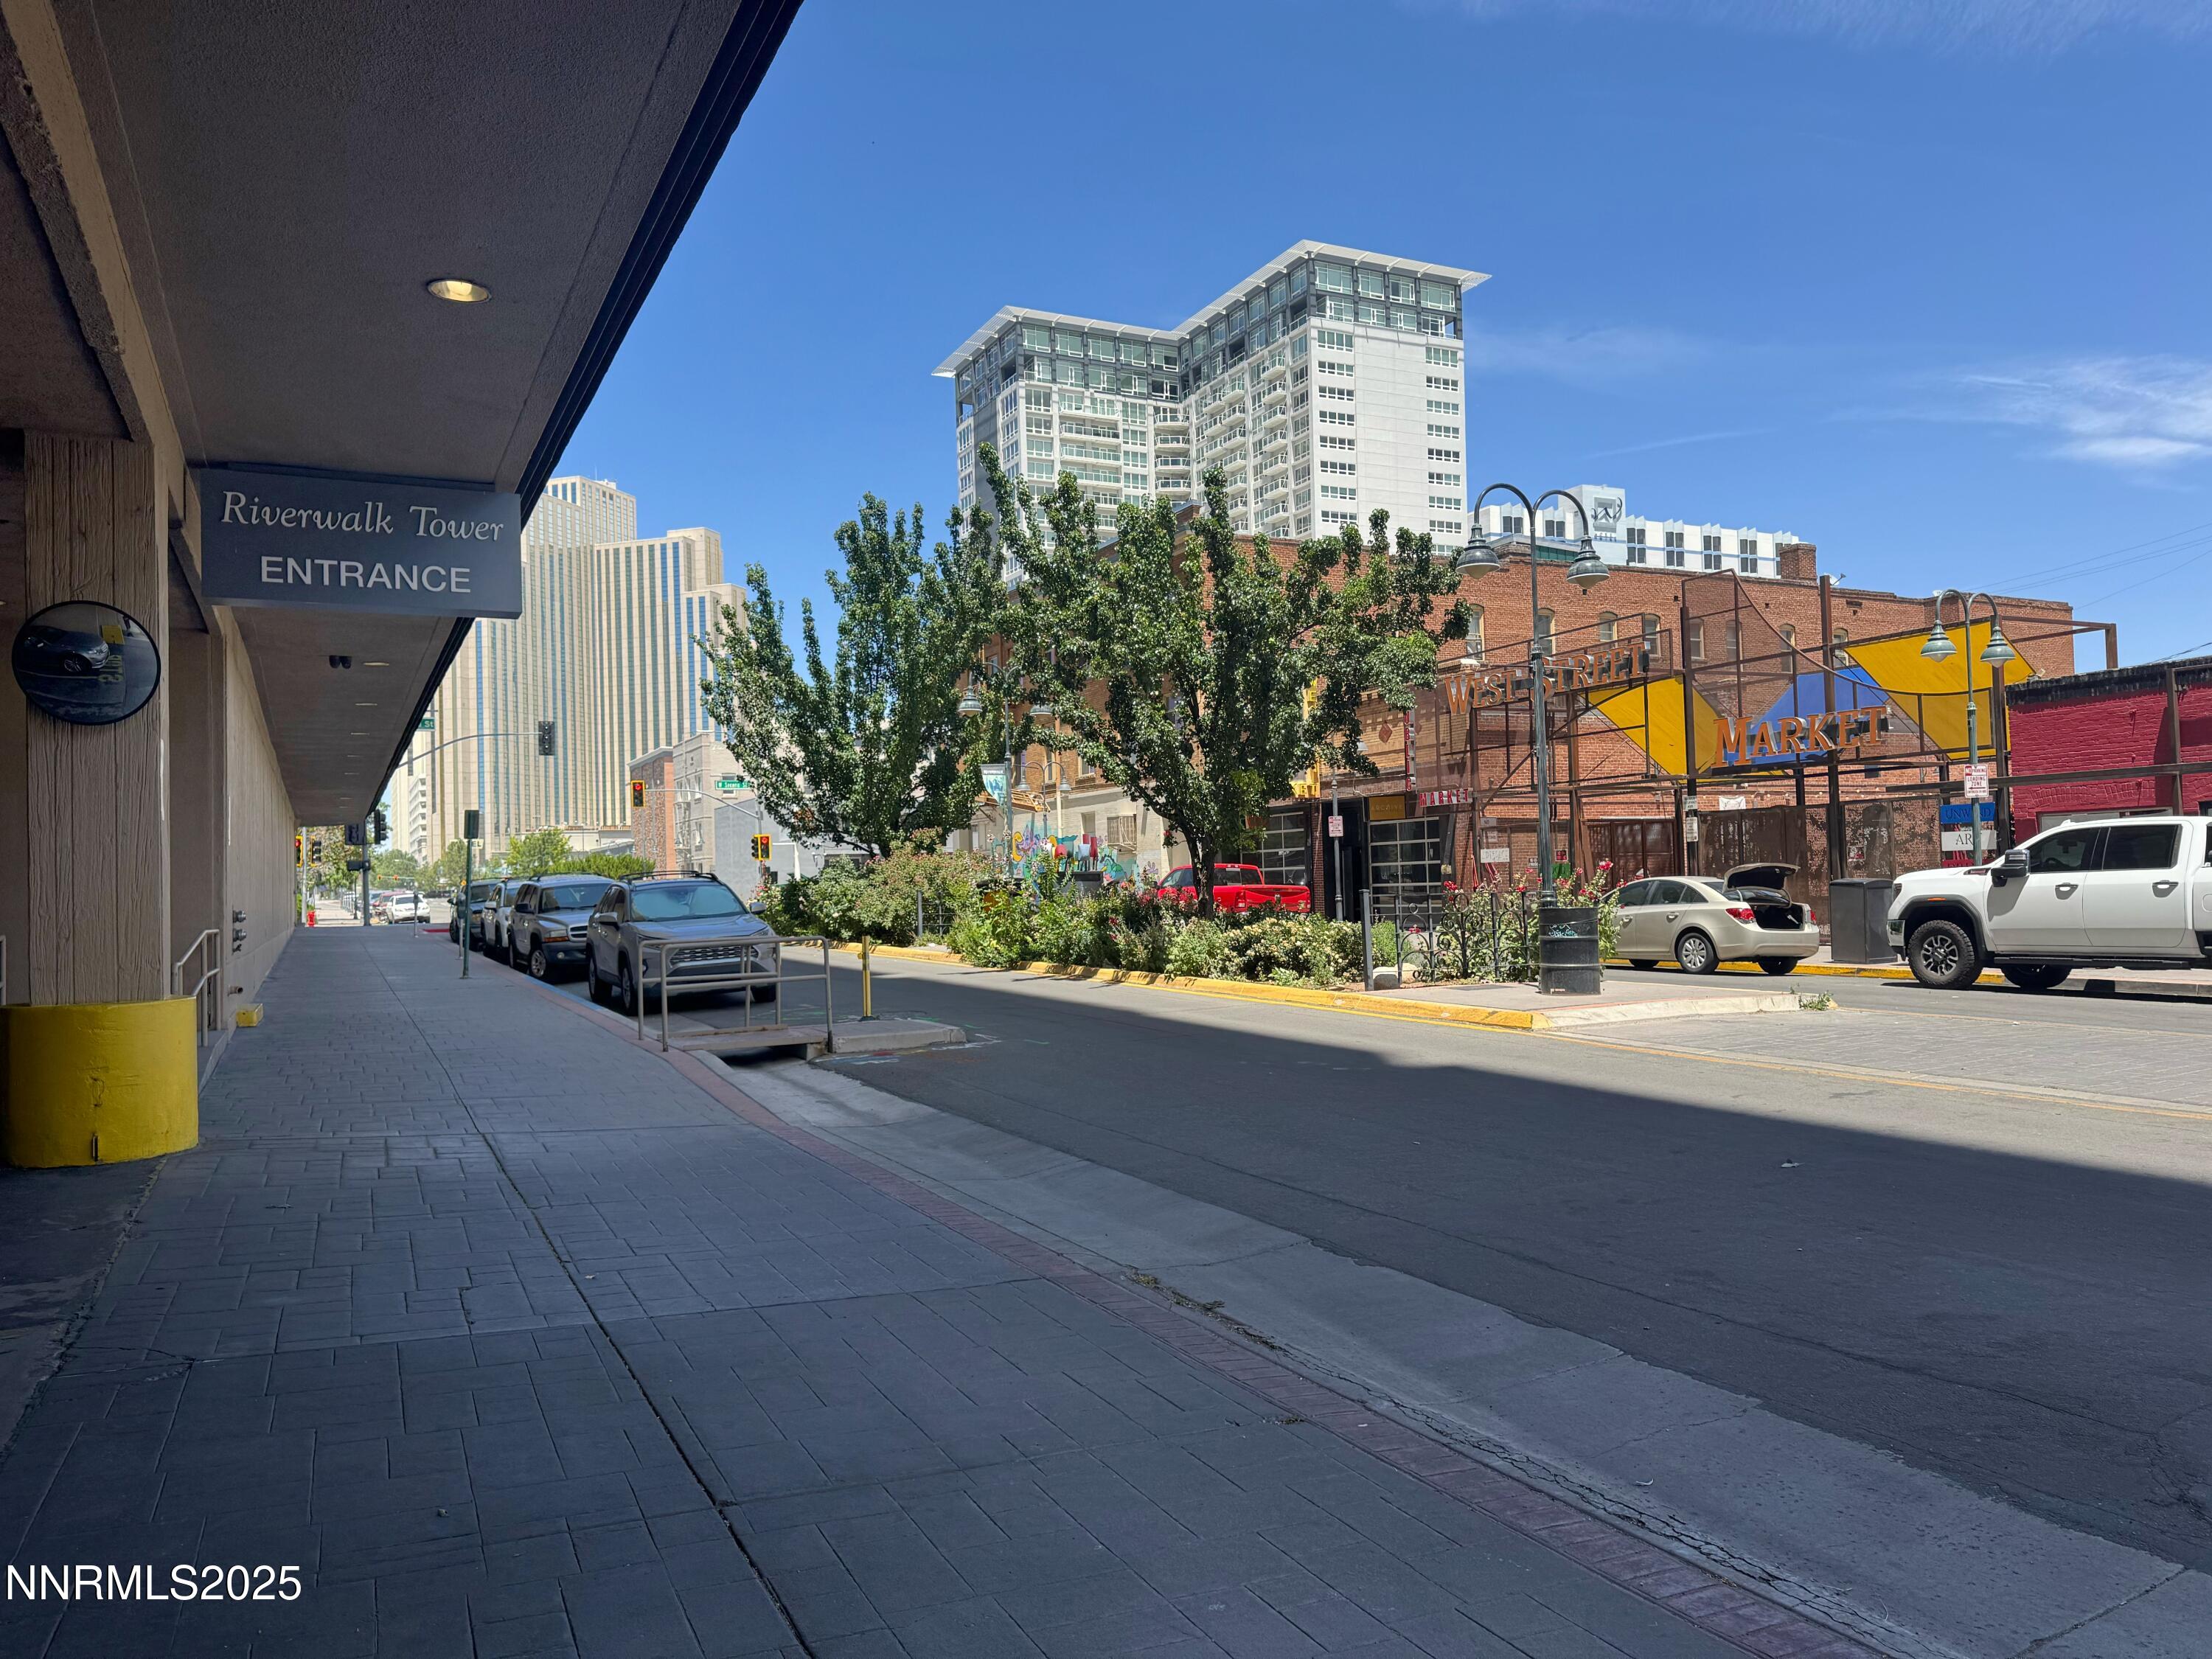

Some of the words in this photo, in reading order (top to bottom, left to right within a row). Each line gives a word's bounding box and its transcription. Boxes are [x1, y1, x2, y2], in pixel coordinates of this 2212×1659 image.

[221, 490, 394, 535] Riverwalk
[410, 506, 504, 541] Tower
[261, 555, 471, 593] ENTRANCE
[1444, 669, 1517, 714] WEST
[1530, 641, 1649, 702] STREET
[1404, 710, 1412, 791] UBLIC
[1711, 706, 1888, 768] MARKET
[1419, 789, 1469, 807] MARKET
[1946, 807, 1991, 820] UNWD
[1955, 833, 1975, 846] AR
